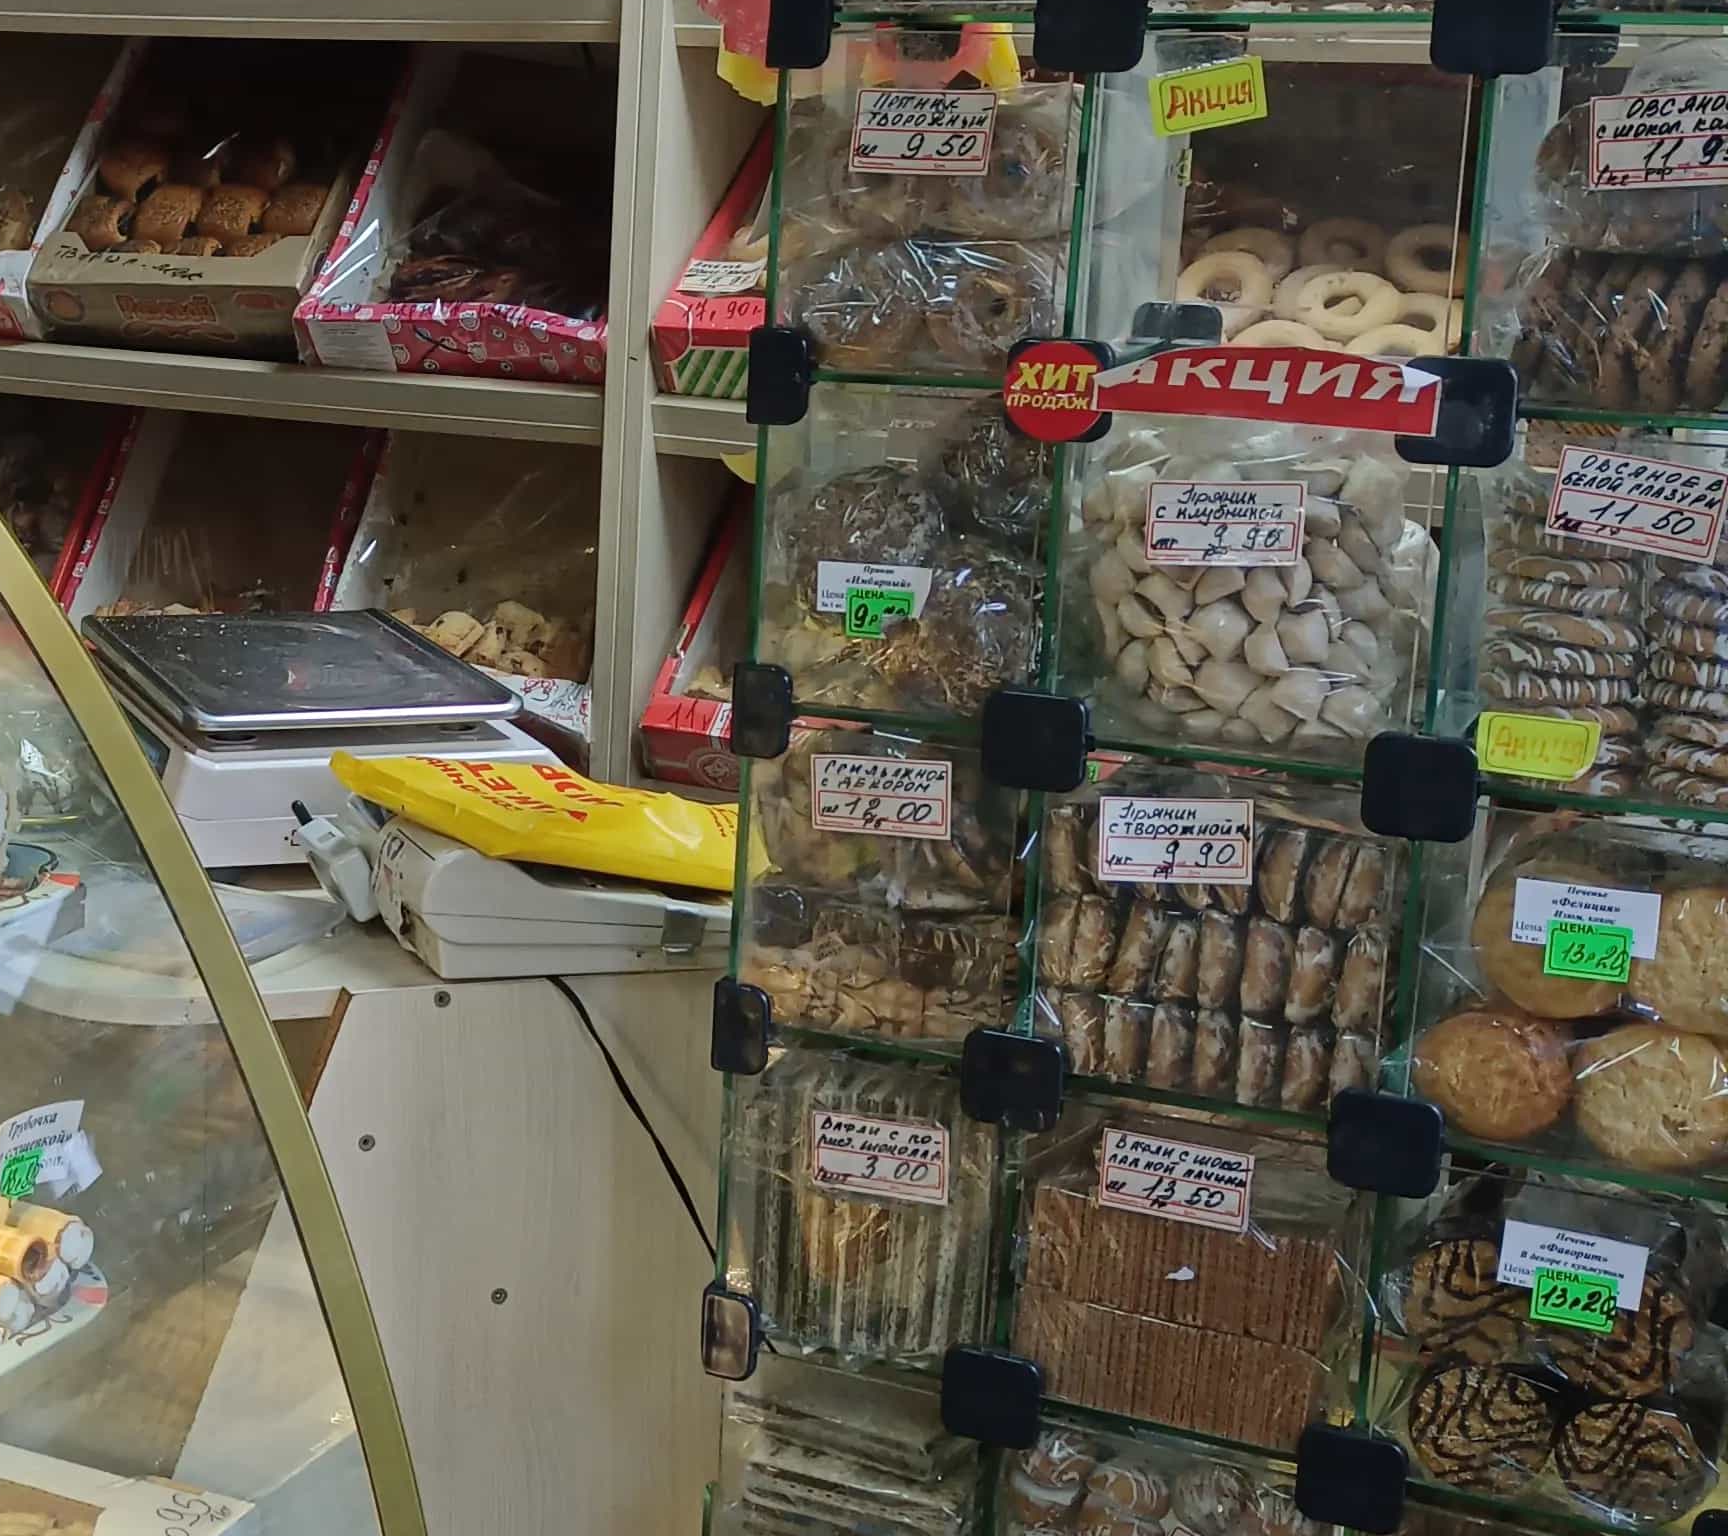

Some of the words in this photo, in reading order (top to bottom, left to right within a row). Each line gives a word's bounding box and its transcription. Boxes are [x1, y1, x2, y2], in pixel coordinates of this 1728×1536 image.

[866, 106, 993, 128] ТВОРОЖНЫЙ
[1014, 361, 1097, 393] ХИТ
[1006, 391, 1091, 411] ПРОДАЖ
[1581, 455, 1701, 488] ОВСЯНОЕ
[1562, 472, 1624, 492] БЕЛОЙ
[1627, 483, 1721, 510] ГЛАЗУРИ
[856, 590, 886, 600] ЦЕНА
[825, 760, 947, 782] ГРИЛЬЯЖНОЕ
[839, 777, 930, 793] ДЕКОРОМ
[821, 1116, 880, 1137] ВАФЛИ
[1116, 1133, 1175, 1160] ВАФЛИ
[1539, 1242, 1608, 1263] «Фаворит»
